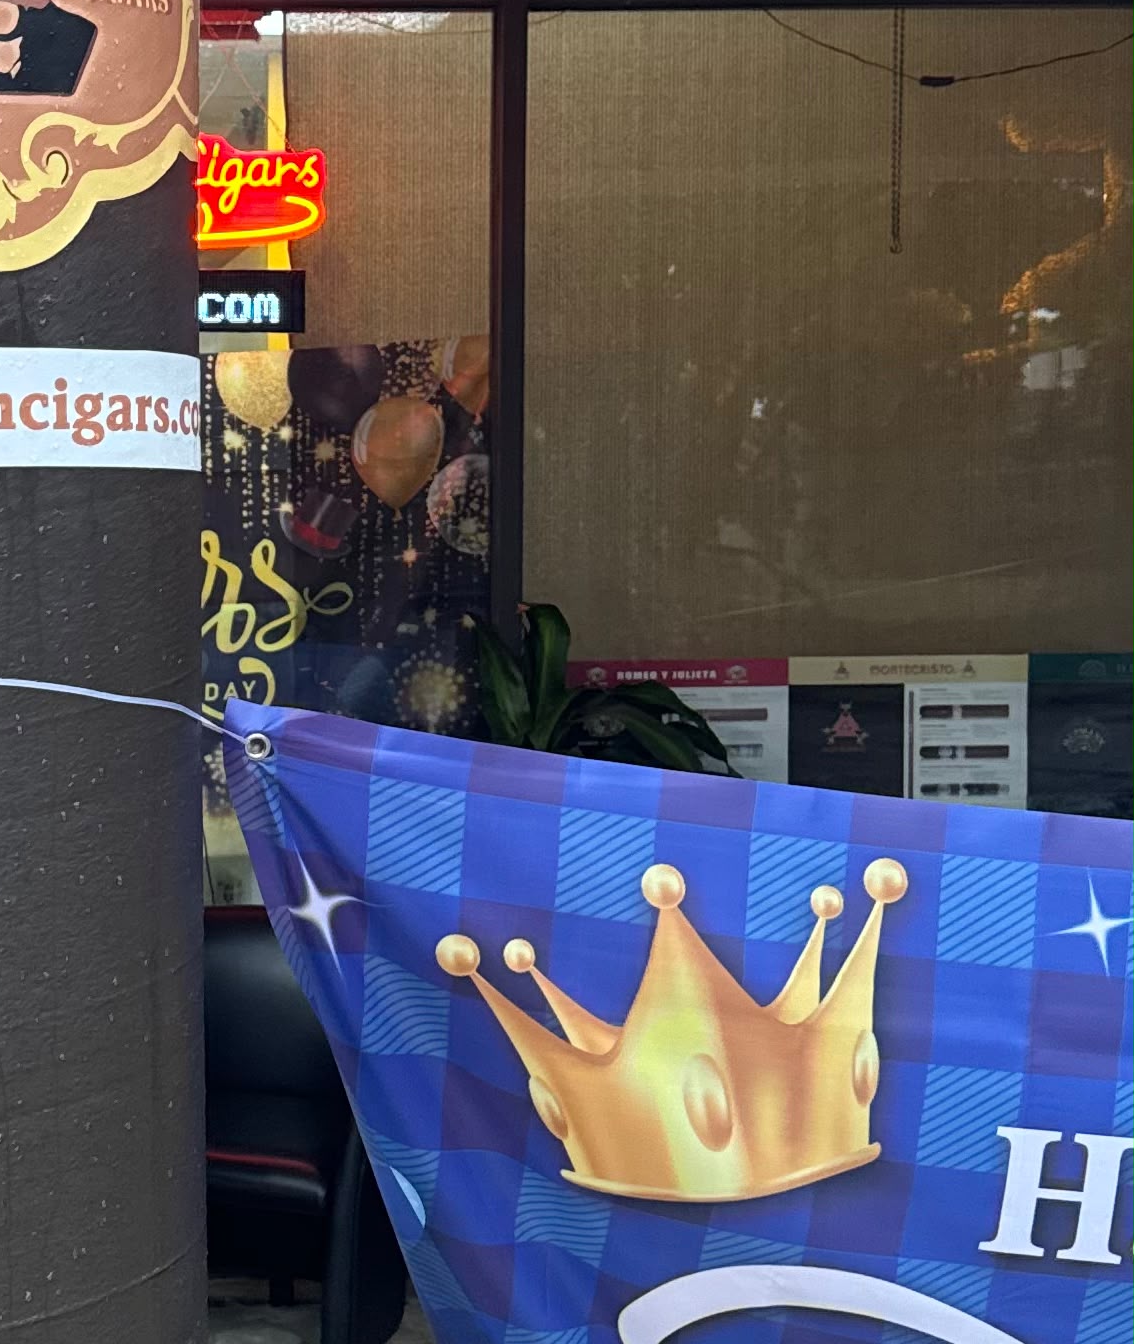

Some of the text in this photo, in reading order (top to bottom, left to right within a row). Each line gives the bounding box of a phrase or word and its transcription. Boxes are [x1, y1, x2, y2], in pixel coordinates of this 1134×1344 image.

[198, 138, 320, 214] igars
[617, 669, 718, 681] ROMEO Y JULIETA
